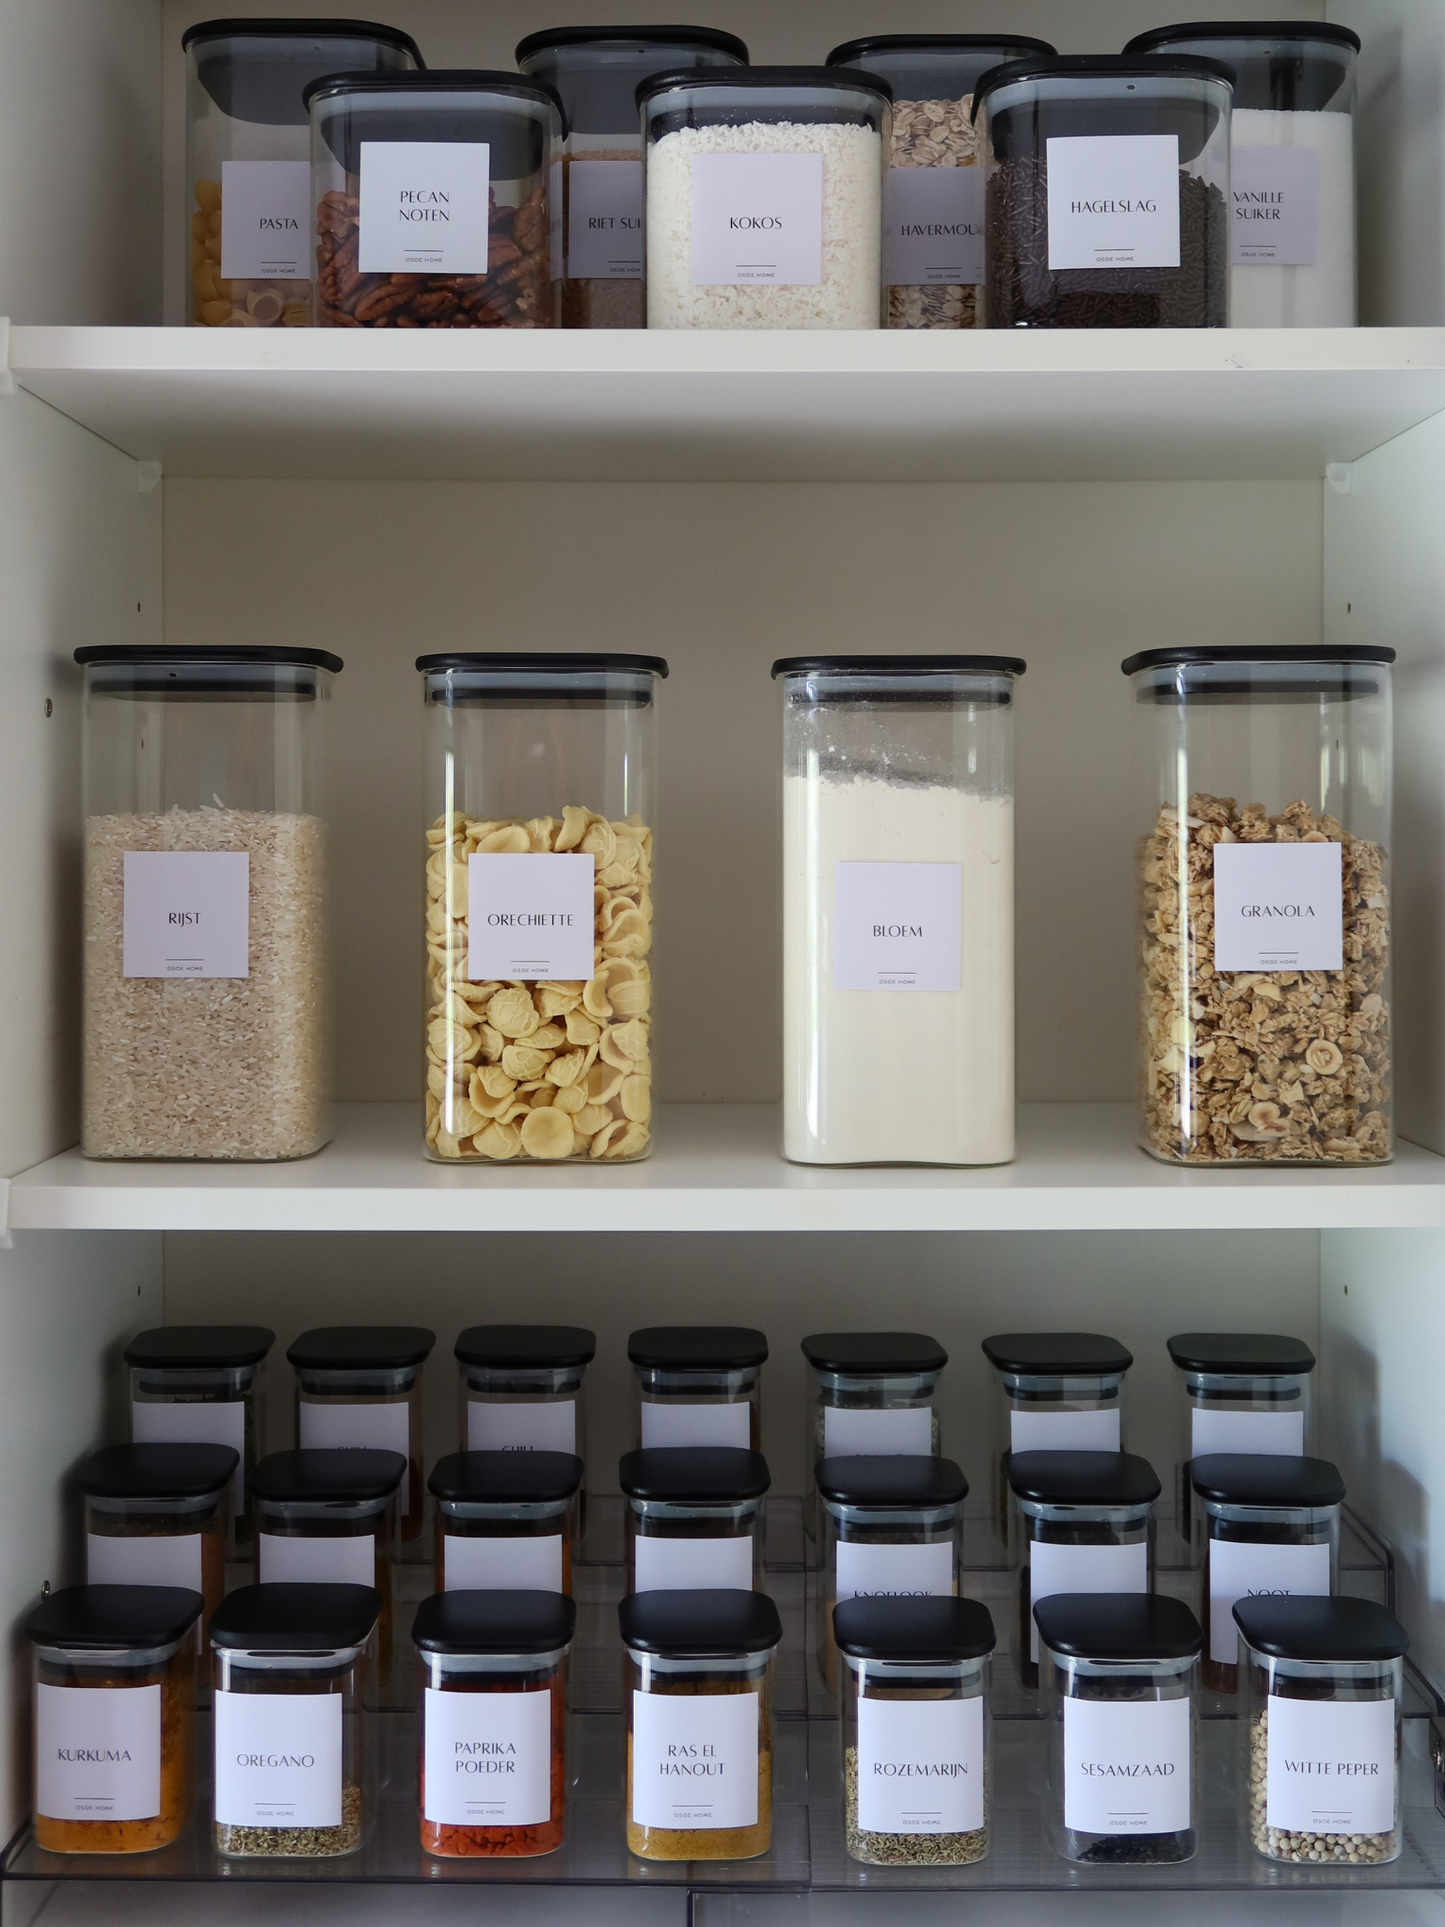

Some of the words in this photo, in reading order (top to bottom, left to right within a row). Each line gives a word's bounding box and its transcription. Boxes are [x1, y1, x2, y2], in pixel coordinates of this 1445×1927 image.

[400, 190, 450, 203] PECAN
[1231, 191, 1284, 204] VANILLE
[1071, 199, 1157, 214] HAGELSLAG
[399, 209, 450, 222] NOTEN
[1235, 208, 1281, 220] SUIKER
[259, 218, 299, 230] PASTA
[588, 217, 615, 229] RIET
[620, 217, 641, 229] SUI
[730, 216, 783, 230] KOKOS
[901, 223, 978, 236] HAVERMOU
[1241, 904, 1316, 918] GRANOLA
[168, 912, 201, 927] RIJST
[487, 914, 574, 926] ORECHIETTE
[873, 925, 923, 938] BLOEM
[454, 1741, 517, 1755] PAPRIKA
[668, 1744, 698, 1758] RAS
[702, 1744, 717, 1757] EL
[57, 1748, 132, 1763] KURKUMA
[236, 1753, 315, 1768] OREGANO
[455, 1760, 515, 1774] POEDER
[660, 1762, 726, 1776] HANOUT
[874, 1762, 968, 1779] ROZEMARIJN
[1081, 1762, 1175, 1777] SESAMZAAD
[1284, 1759, 1331, 1775] WITTE
[1337, 1762, 1379, 1776] PEPER
